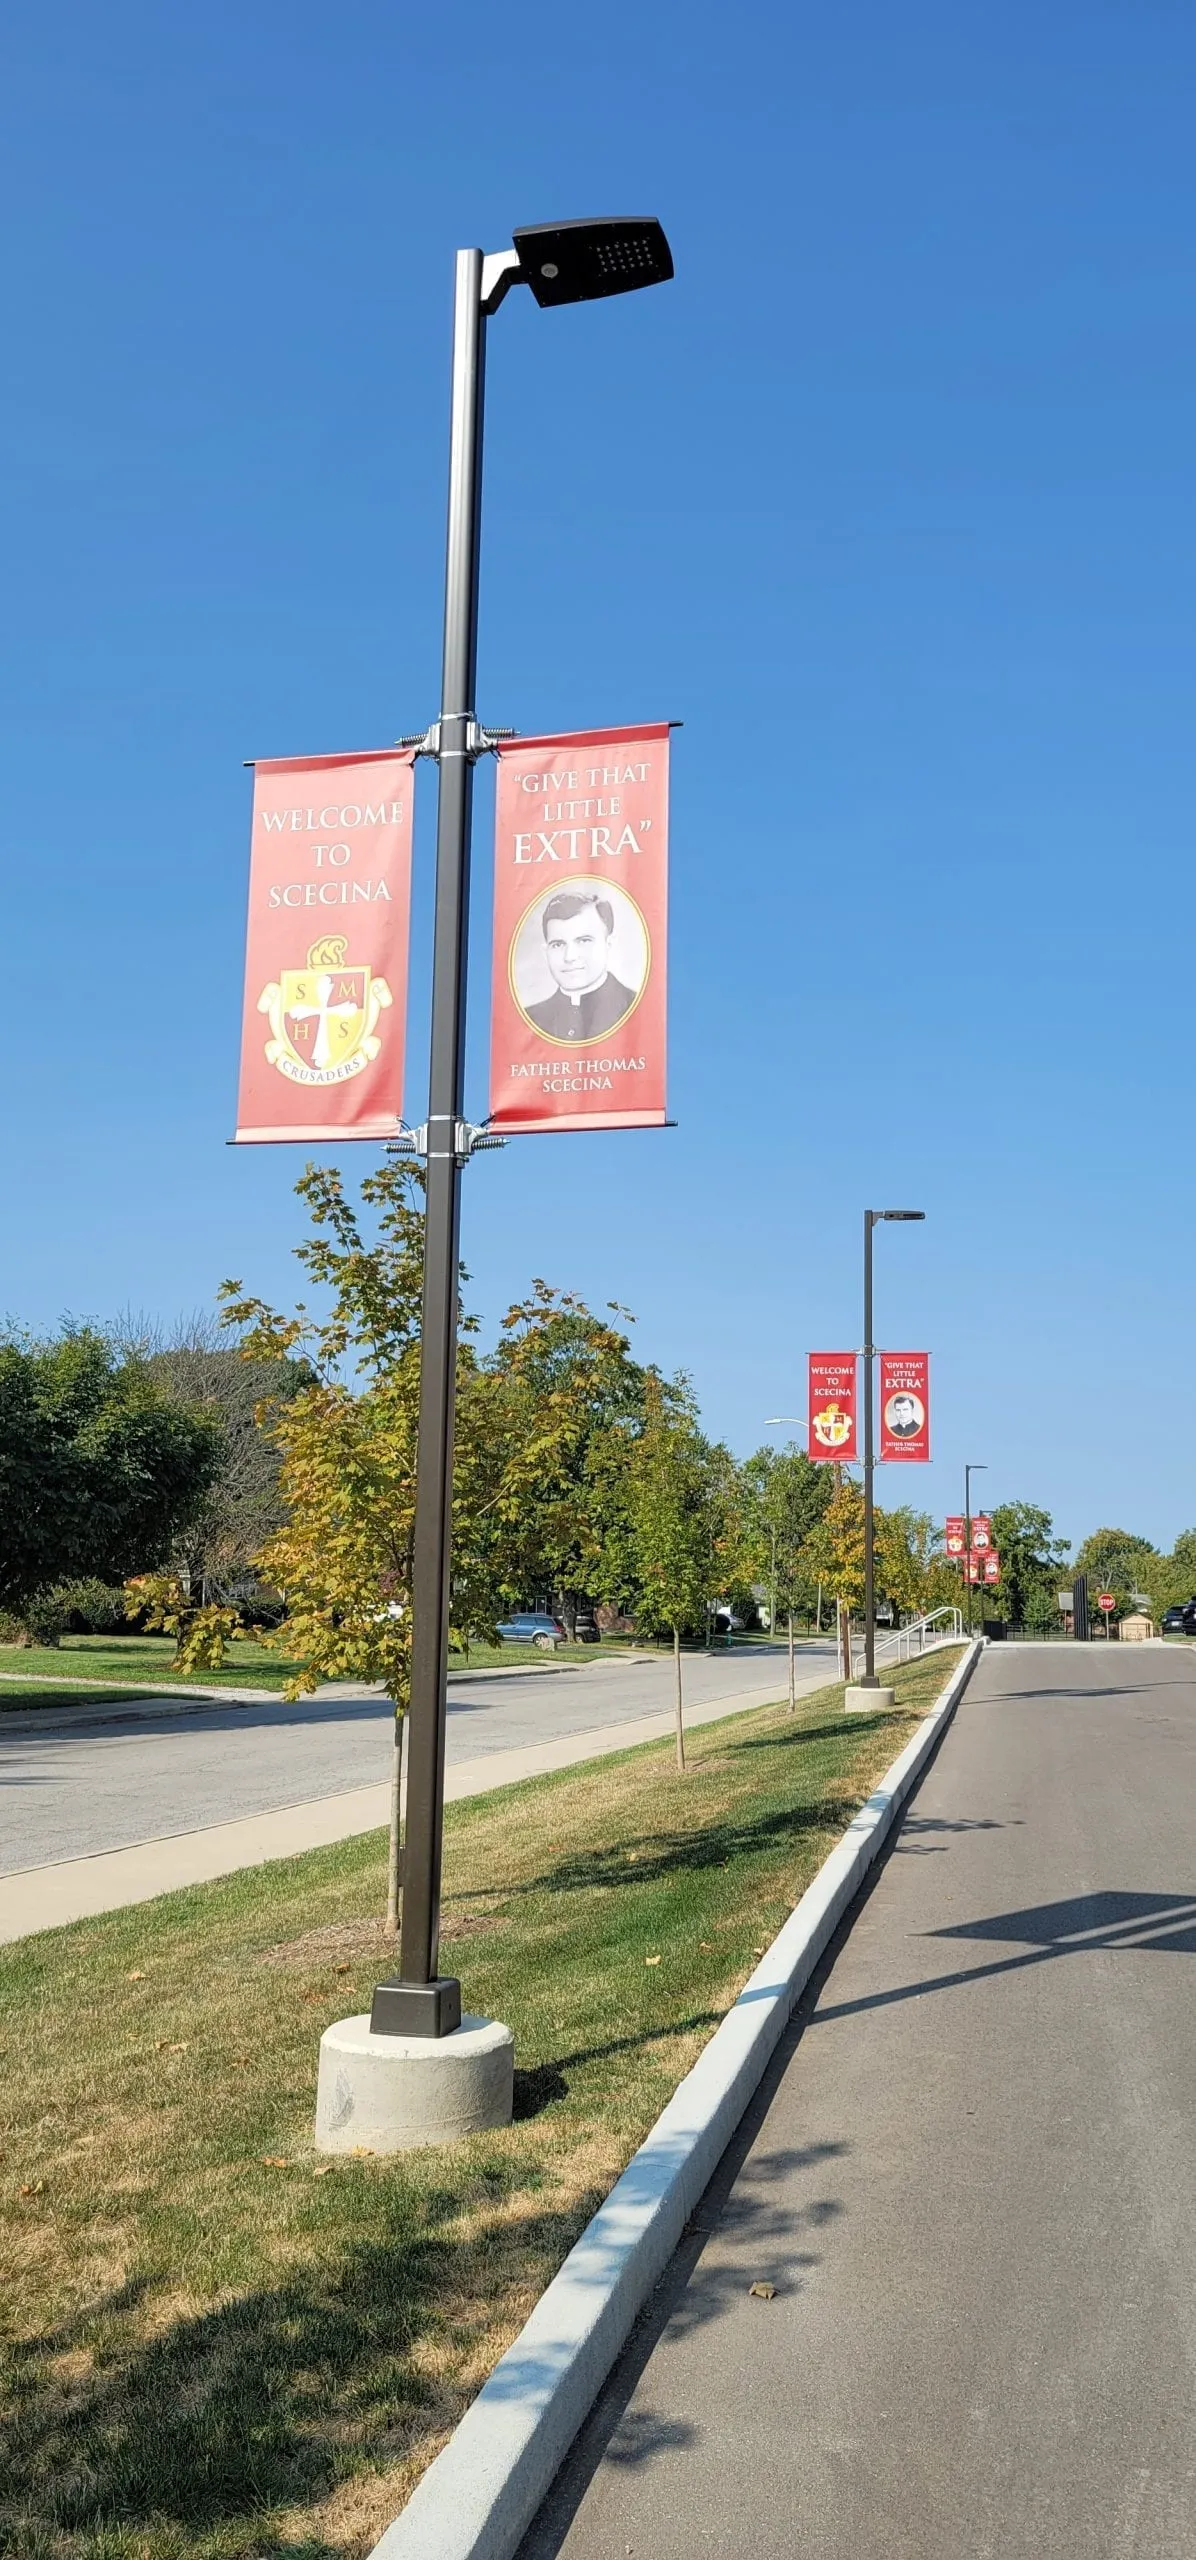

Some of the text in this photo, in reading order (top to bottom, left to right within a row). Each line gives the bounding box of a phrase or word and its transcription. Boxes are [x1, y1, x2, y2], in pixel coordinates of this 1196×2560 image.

[514, 763, 651, 793] “GIVE THAT
[260, 801, 404, 832] WELCOME
[543, 797, 621, 822] LITTLE
[512, 819, 652, 865] EXTRA”
[310, 843, 351, 867] TO
[268, 879, 392, 908] SCECINA
[295, 981, 357, 1000] S M
[293, 1021, 349, 1040] H S
[282, 1057, 360, 1082] CRUSADERS
[511, 1057, 646, 1077] FATHER THOMAS
[542, 1077, 613, 1093] SCECINA
[811, 1366, 855, 1375] WELCOME
[826, 1377, 840, 1386] TO
[814, 1388, 852, 1396] SCECINA
[1100, 1598, 1114, 1606] STOP
